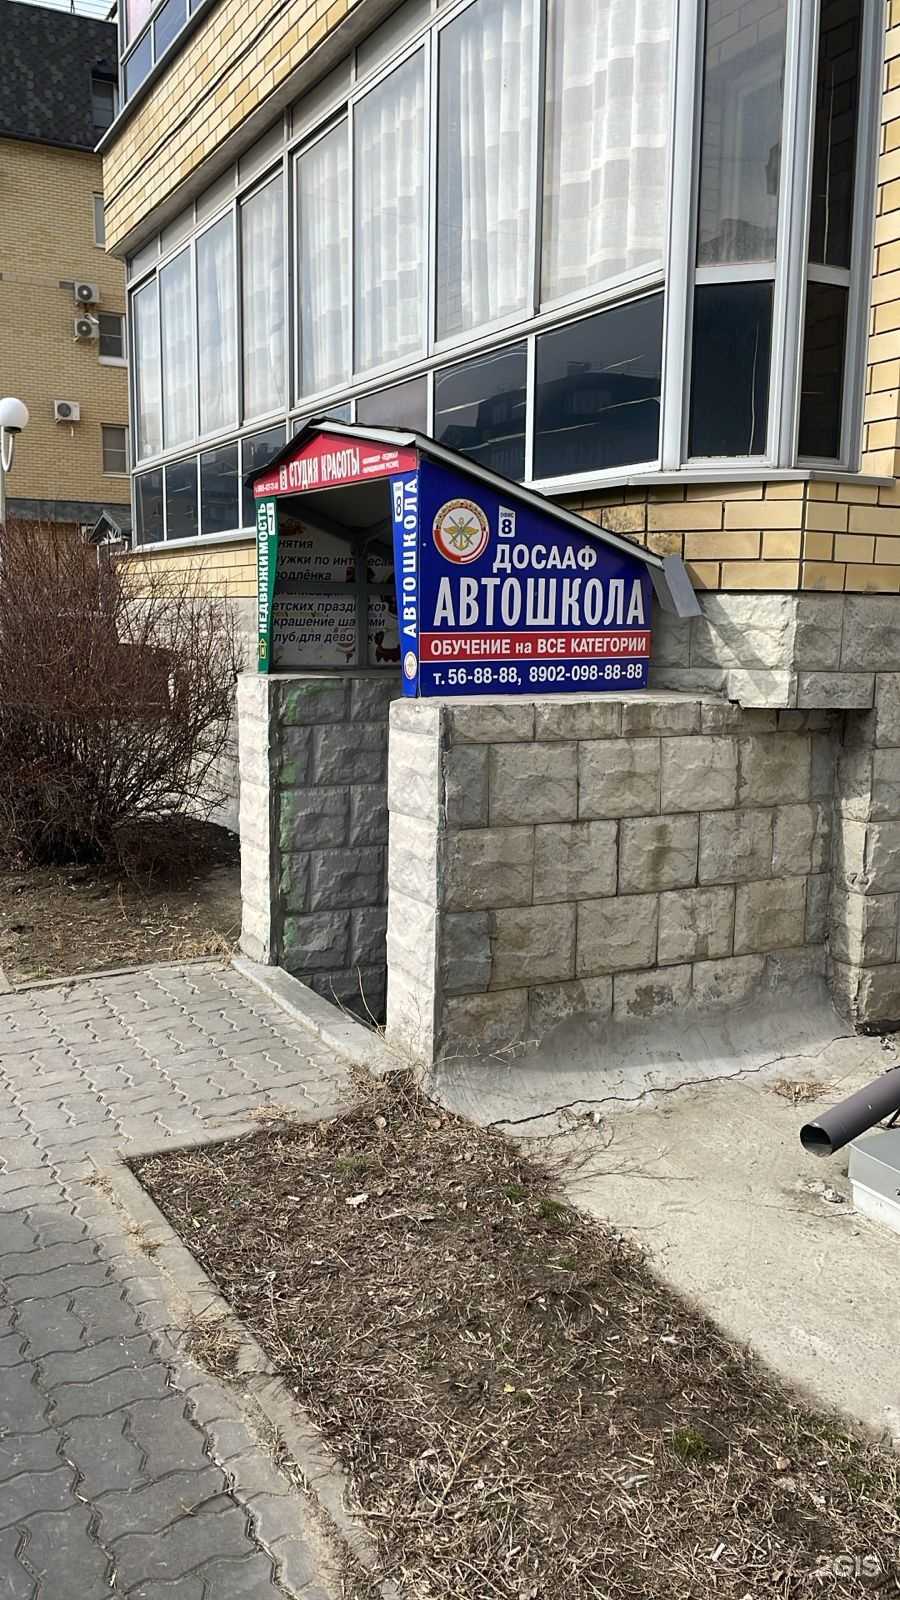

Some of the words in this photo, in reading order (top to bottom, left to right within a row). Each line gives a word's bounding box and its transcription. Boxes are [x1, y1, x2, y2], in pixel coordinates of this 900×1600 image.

[289, 457, 319, 489] СТУДИЯ
[321, 447, 360, 481] КРАСОТЫ
[501, 518, 512, 534] 8
[257, 503, 269, 633] НЕДВИЖИМОСТЬ
[277, 555, 312, 566] ужки
[315, 556, 330, 565] по
[403, 478, 418, 638] АВТОШКОЛА
[492, 544, 597, 573] ДОСААФ
[433, 576, 645, 626] АВТОШКОЛА
[298, 633, 321, 644] для
[430, 639, 511, 655] ОБУЧЕНИЕ
[515, 642, 532, 654] на
[537, 638, 566, 653] ВСЕ
[571, 637, 646, 653] КАТЕГОРИИ
[529, 664, 643, 682] 8902-098-88-88
